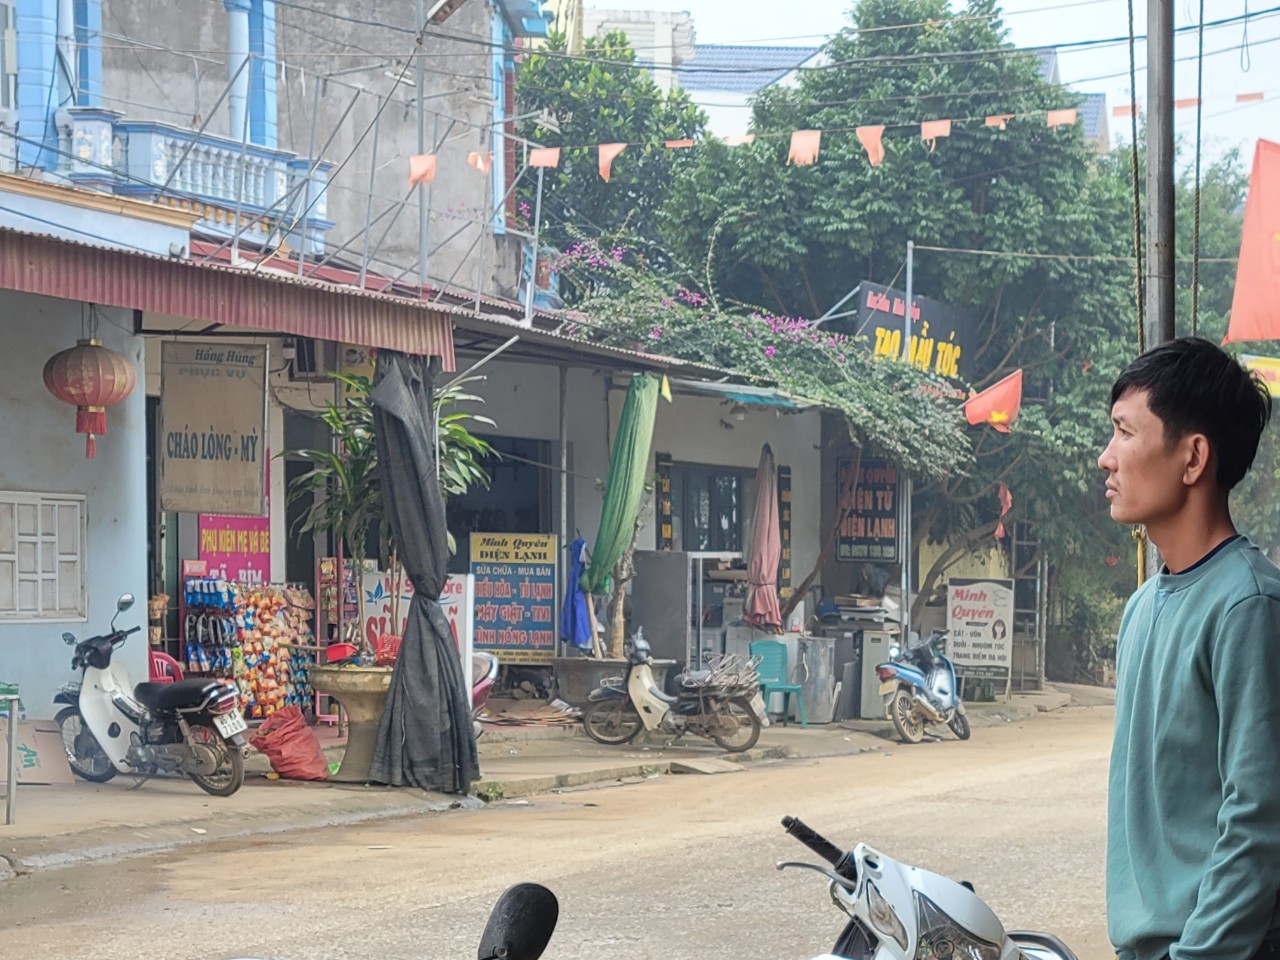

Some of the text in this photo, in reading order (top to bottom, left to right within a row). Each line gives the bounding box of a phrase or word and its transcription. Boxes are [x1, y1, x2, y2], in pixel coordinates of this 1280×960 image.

[167, 423, 199, 460] CHÁO
[201, 424, 232, 461] LÒNG
[241, 427, 258, 462] MỲ
[952, 588, 988, 602] Minh
